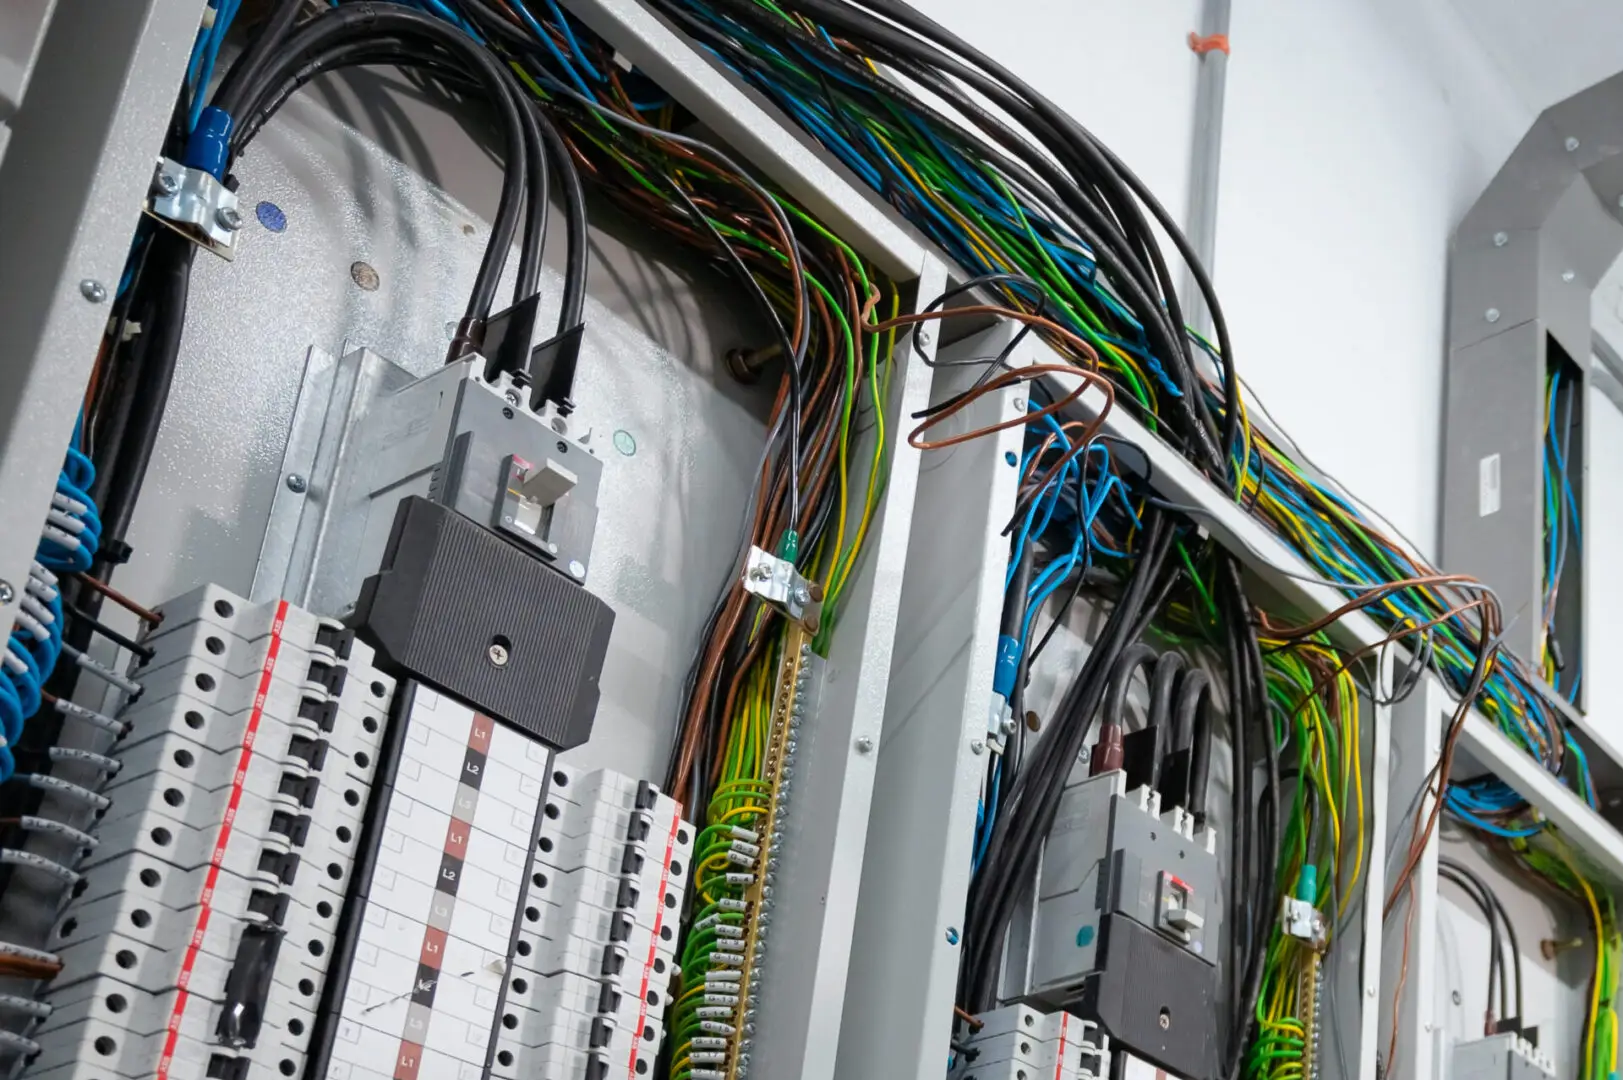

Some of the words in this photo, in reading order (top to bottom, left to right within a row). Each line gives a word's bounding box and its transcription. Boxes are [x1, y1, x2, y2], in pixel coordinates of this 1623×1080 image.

[475, 729, 486, 739] L1
[467, 762, 479, 774] L2
[451, 833, 462, 844] L1
[443, 868, 455, 880] L2
[427, 941, 438, 953] L1
[402, 1055, 414, 1067] L1
